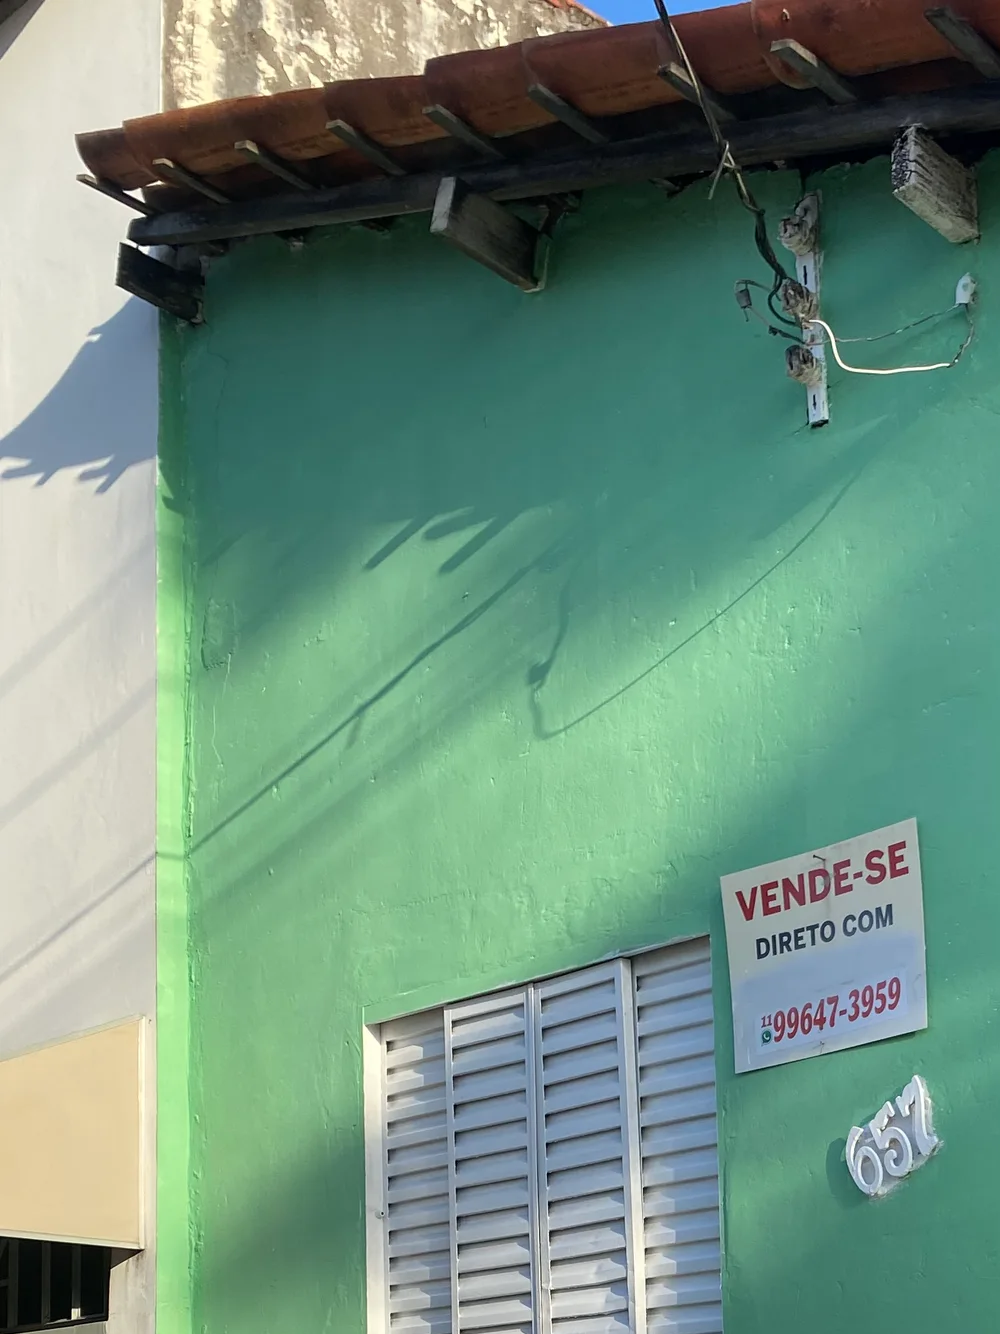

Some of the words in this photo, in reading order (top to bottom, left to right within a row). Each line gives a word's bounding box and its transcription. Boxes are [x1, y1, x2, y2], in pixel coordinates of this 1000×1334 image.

[735, 840, 909, 922] VENDE-SE
[755, 920, 836, 960] DIRETO
[842, 903, 894, 937] COM
[773, 976, 901, 1043] 99647-3959
[845, 1074, 938, 1197] 657
